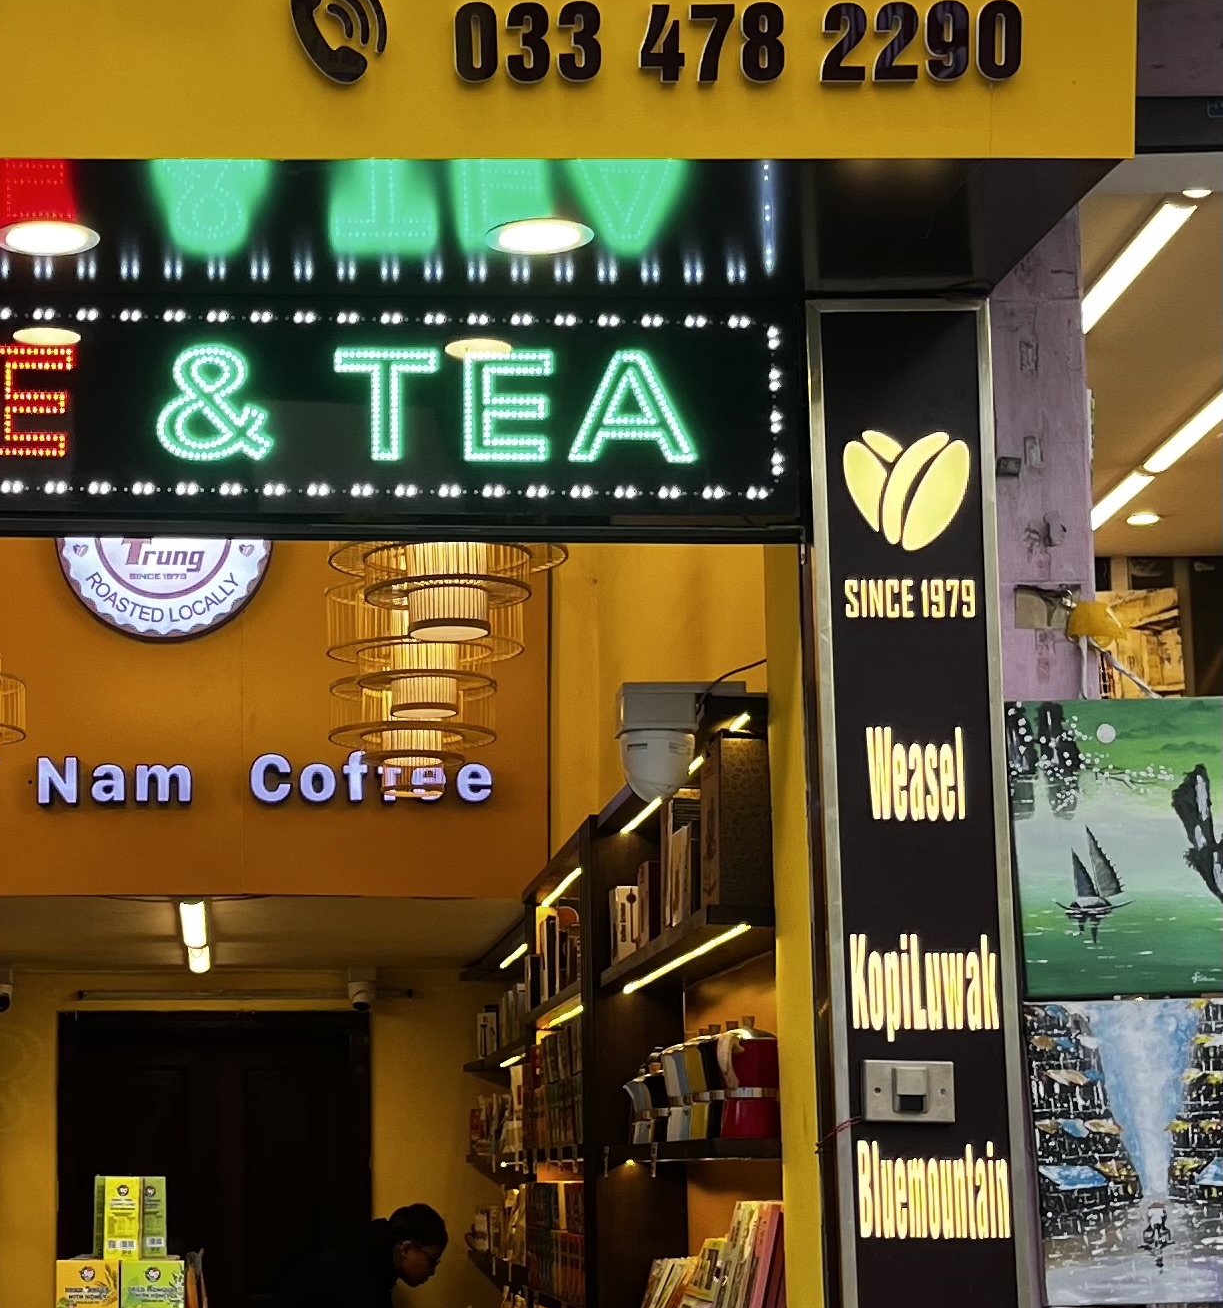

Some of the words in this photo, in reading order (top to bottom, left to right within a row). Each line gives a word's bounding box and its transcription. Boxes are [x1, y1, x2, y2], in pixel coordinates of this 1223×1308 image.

[454, 0, 603, 83] 033
[641, 0, 786, 83] 478
[821, 0, 1025, 83] 2290
[156, 343, 274, 463] &
[334, 349, 699, 464] TEA
[121, 537, 205, 573] Trung
[85, 572, 165, 624] ROASTED
[168, 572, 240, 624] LOCALLY
[844, 579, 915, 619] SINCE
[920, 578, 977, 619] 1979
[37, 755, 192, 805] Nam
[865, 725, 966, 822] Weasel
[856, 1140, 1012, 1240] Bluemountain
